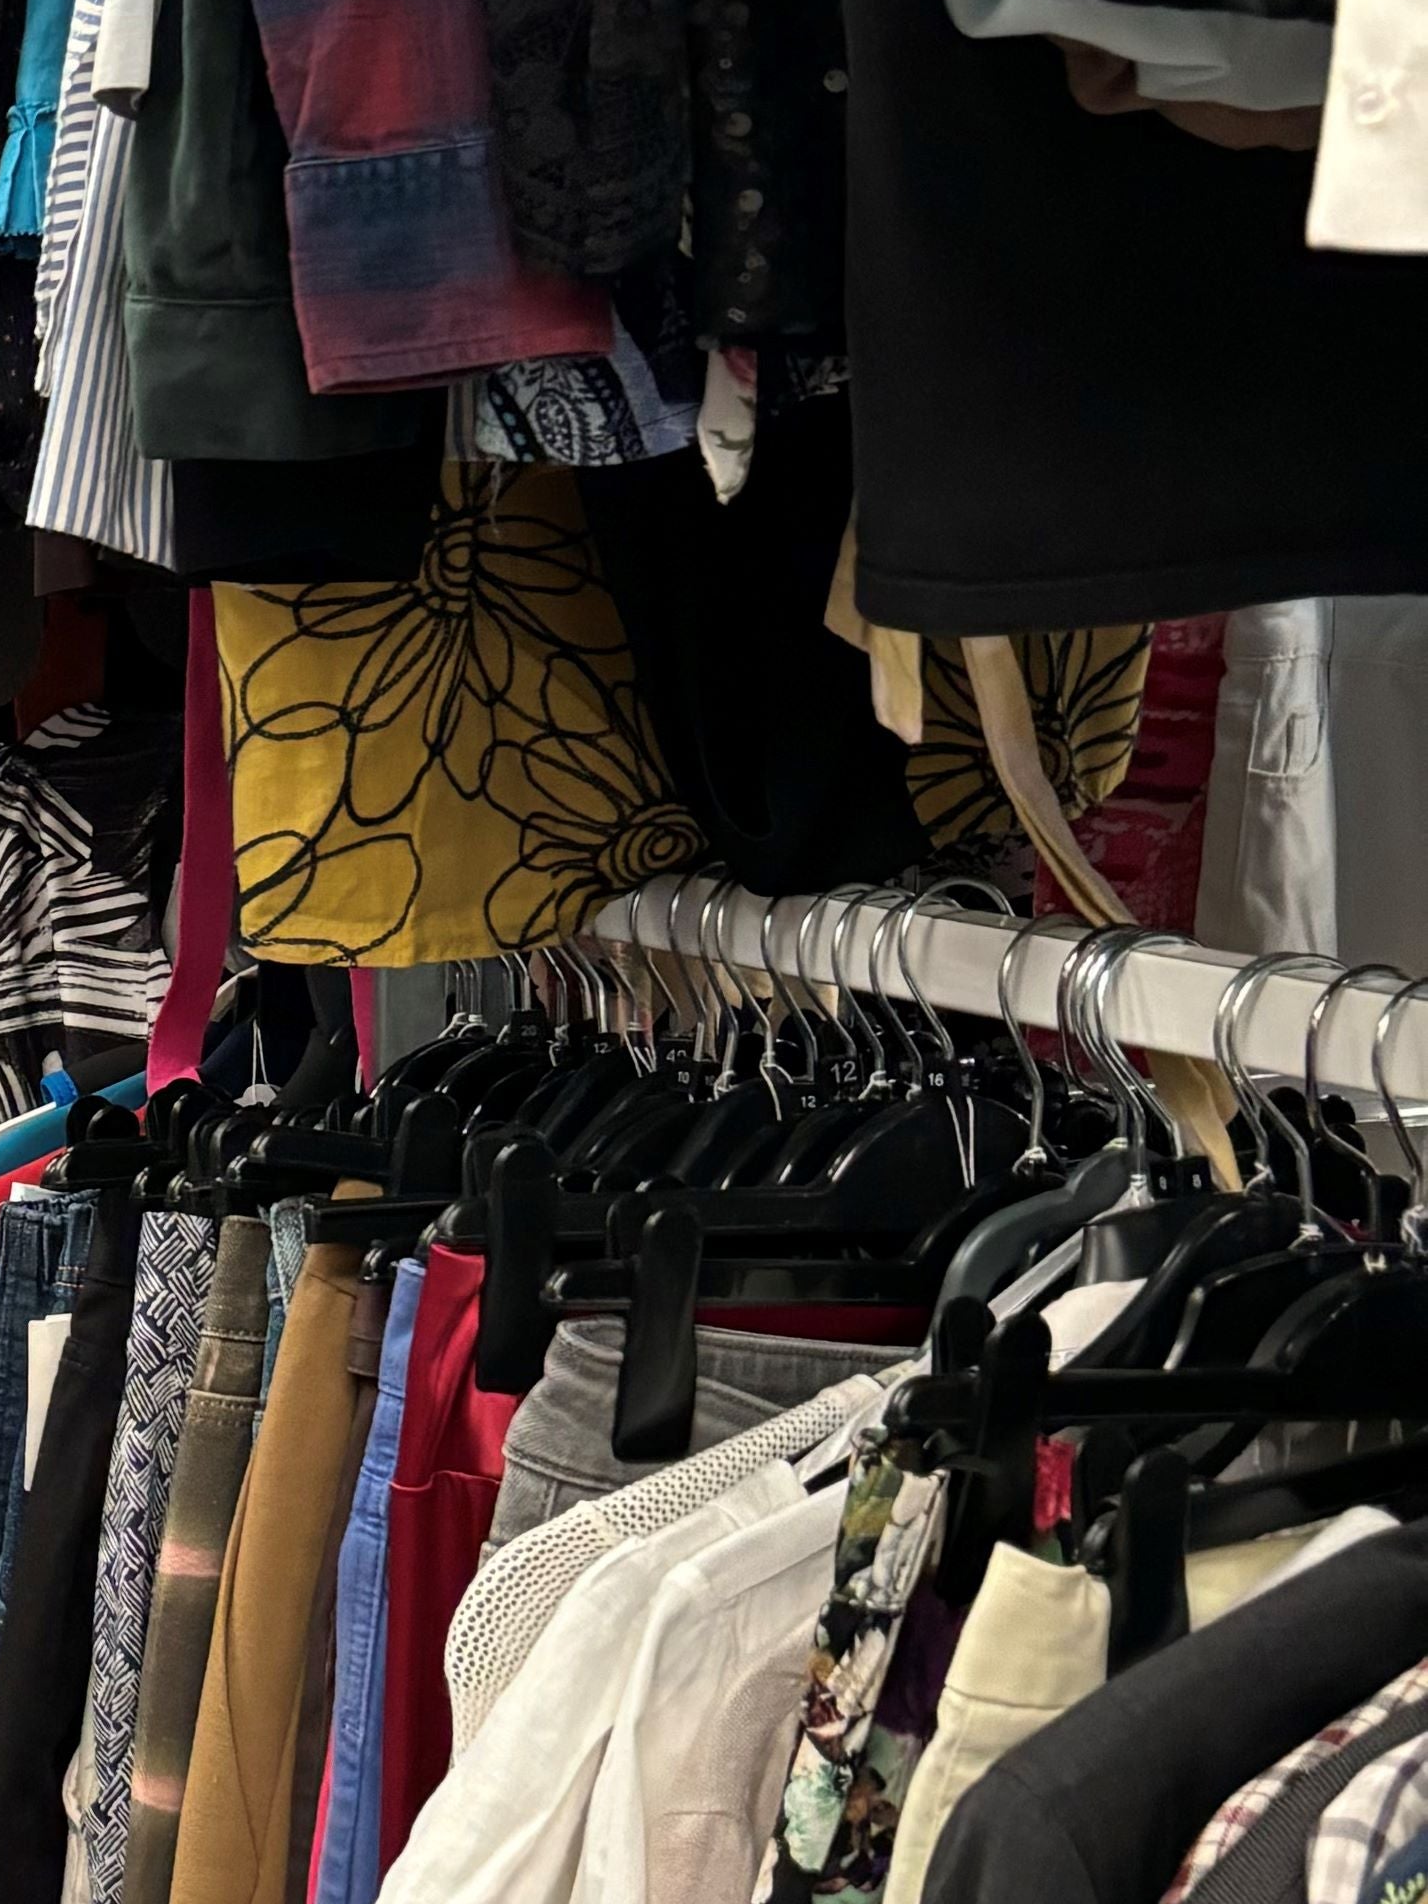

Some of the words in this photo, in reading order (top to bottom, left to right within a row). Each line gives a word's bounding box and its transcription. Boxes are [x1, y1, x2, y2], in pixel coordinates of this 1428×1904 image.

[830, 1061, 857, 1084] 12
[928, 1073, 944, 1087] 16
[801, 1096, 816, 1109] 12
